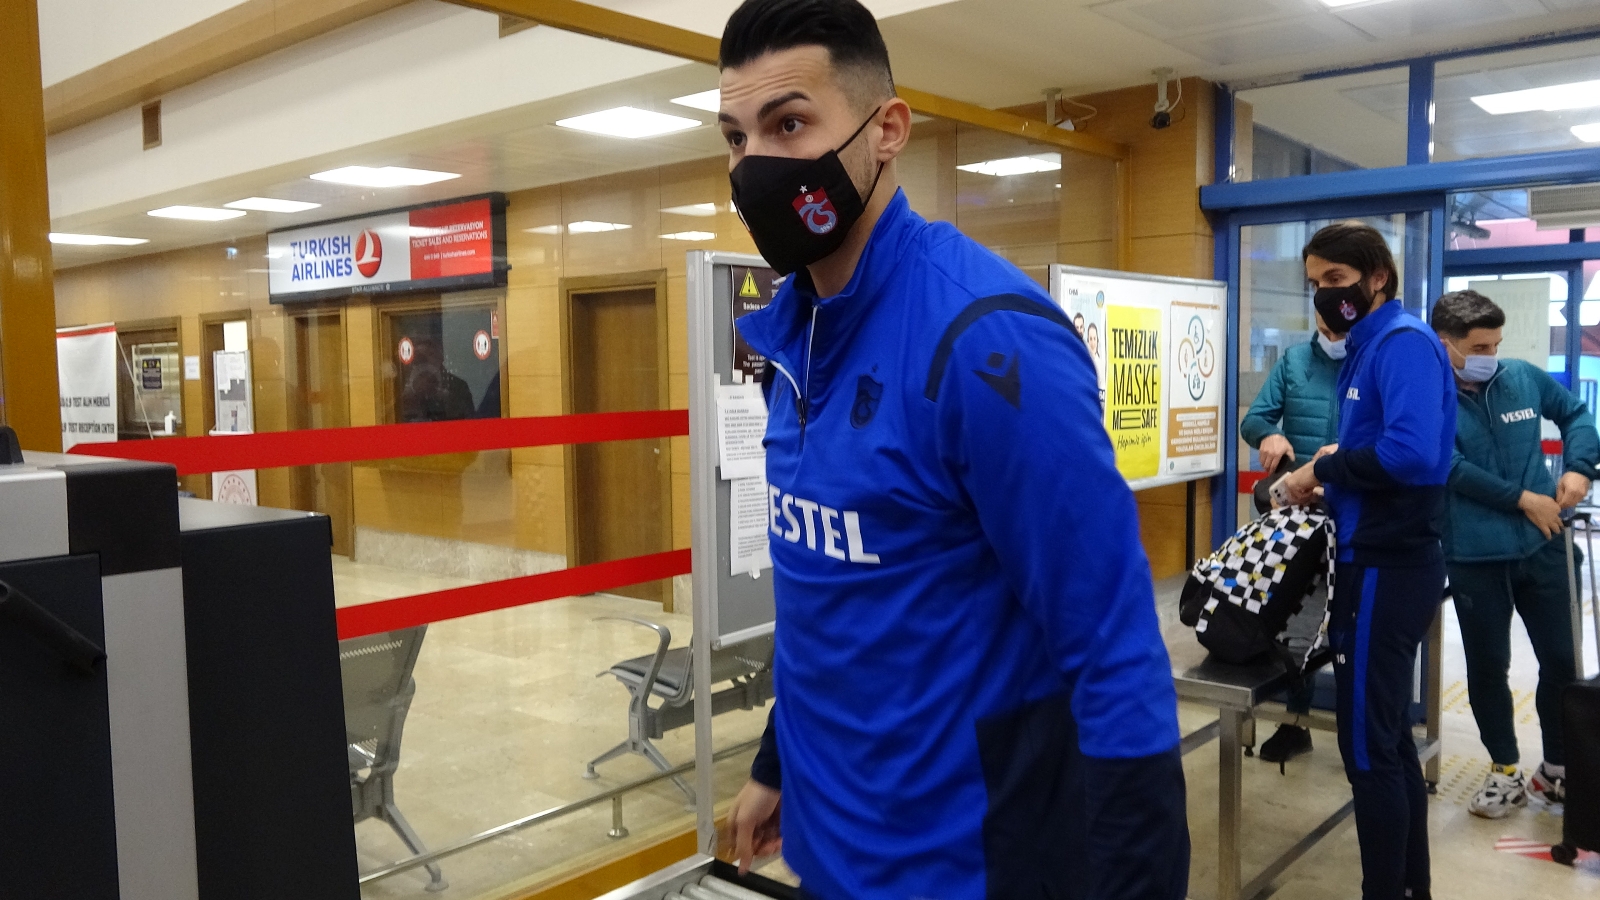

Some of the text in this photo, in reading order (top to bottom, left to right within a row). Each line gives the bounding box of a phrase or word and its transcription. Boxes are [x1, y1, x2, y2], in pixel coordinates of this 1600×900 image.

[290, 235, 351, 260] TURKISH
[291, 257, 353, 282] AIRLINES
[1112, 328, 1158, 360] TEMİZLİK
[1113, 363, 1158, 405] MASKE
[1500, 407, 1538, 424] VESTEL
[1116, 433, 1140, 451] Hepimiz
[1141, 431, 1152, 448] için
[767, 483, 881, 564] ESTEL
[1336, 653, 1346, 665] 16
